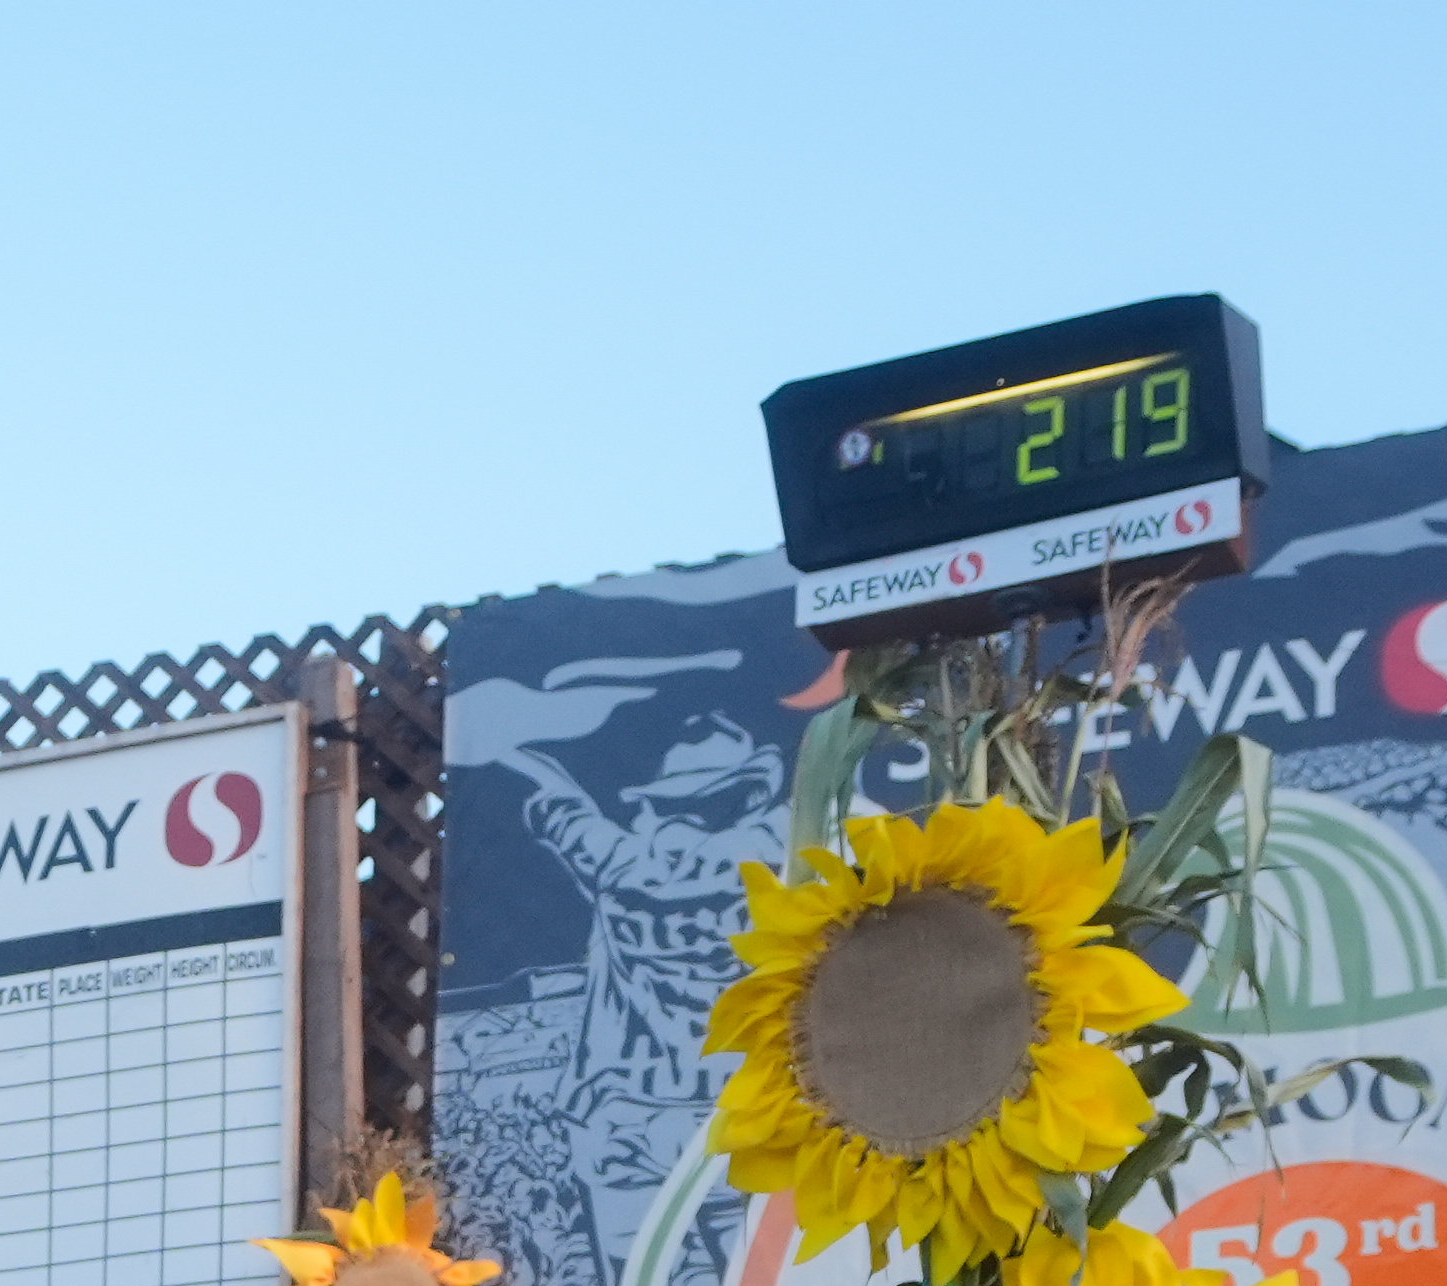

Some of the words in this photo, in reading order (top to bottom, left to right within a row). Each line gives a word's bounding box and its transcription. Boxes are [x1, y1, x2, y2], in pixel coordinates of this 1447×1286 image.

[1015, 367, 1191, 486] 219
[1032, 512, 1170, 565] SAFEWAY
[812, 561, 943, 611] SAFEWAY
[59, 971, 103, 996] PLACE
[111, 963, 163, 989] WEIGHT
[171, 954, 218, 979] HEIGHT
